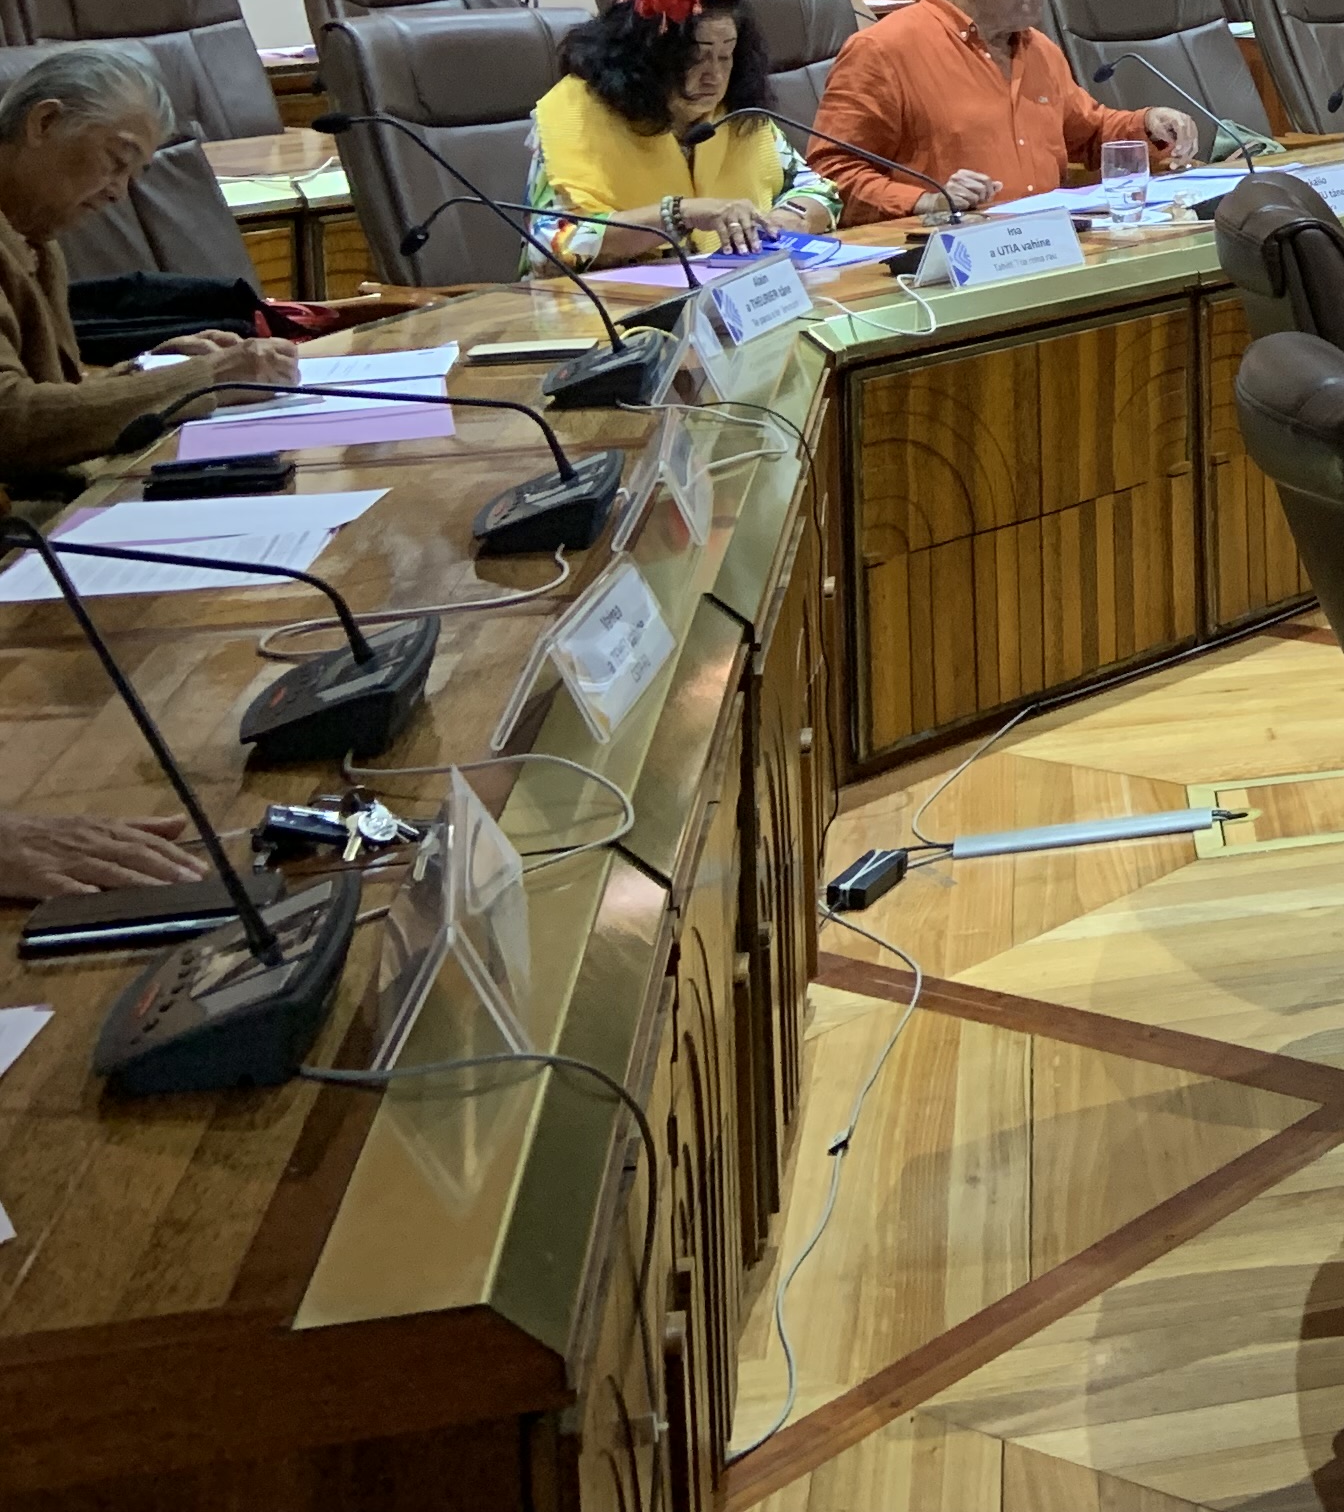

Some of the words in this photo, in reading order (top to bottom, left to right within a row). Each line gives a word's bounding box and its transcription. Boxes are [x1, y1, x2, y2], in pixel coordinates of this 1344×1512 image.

[1007, 226, 1022, 236] Ina
[997, 241, 1021, 256] UTIA
[1021, 238, 1052, 251] vahine
